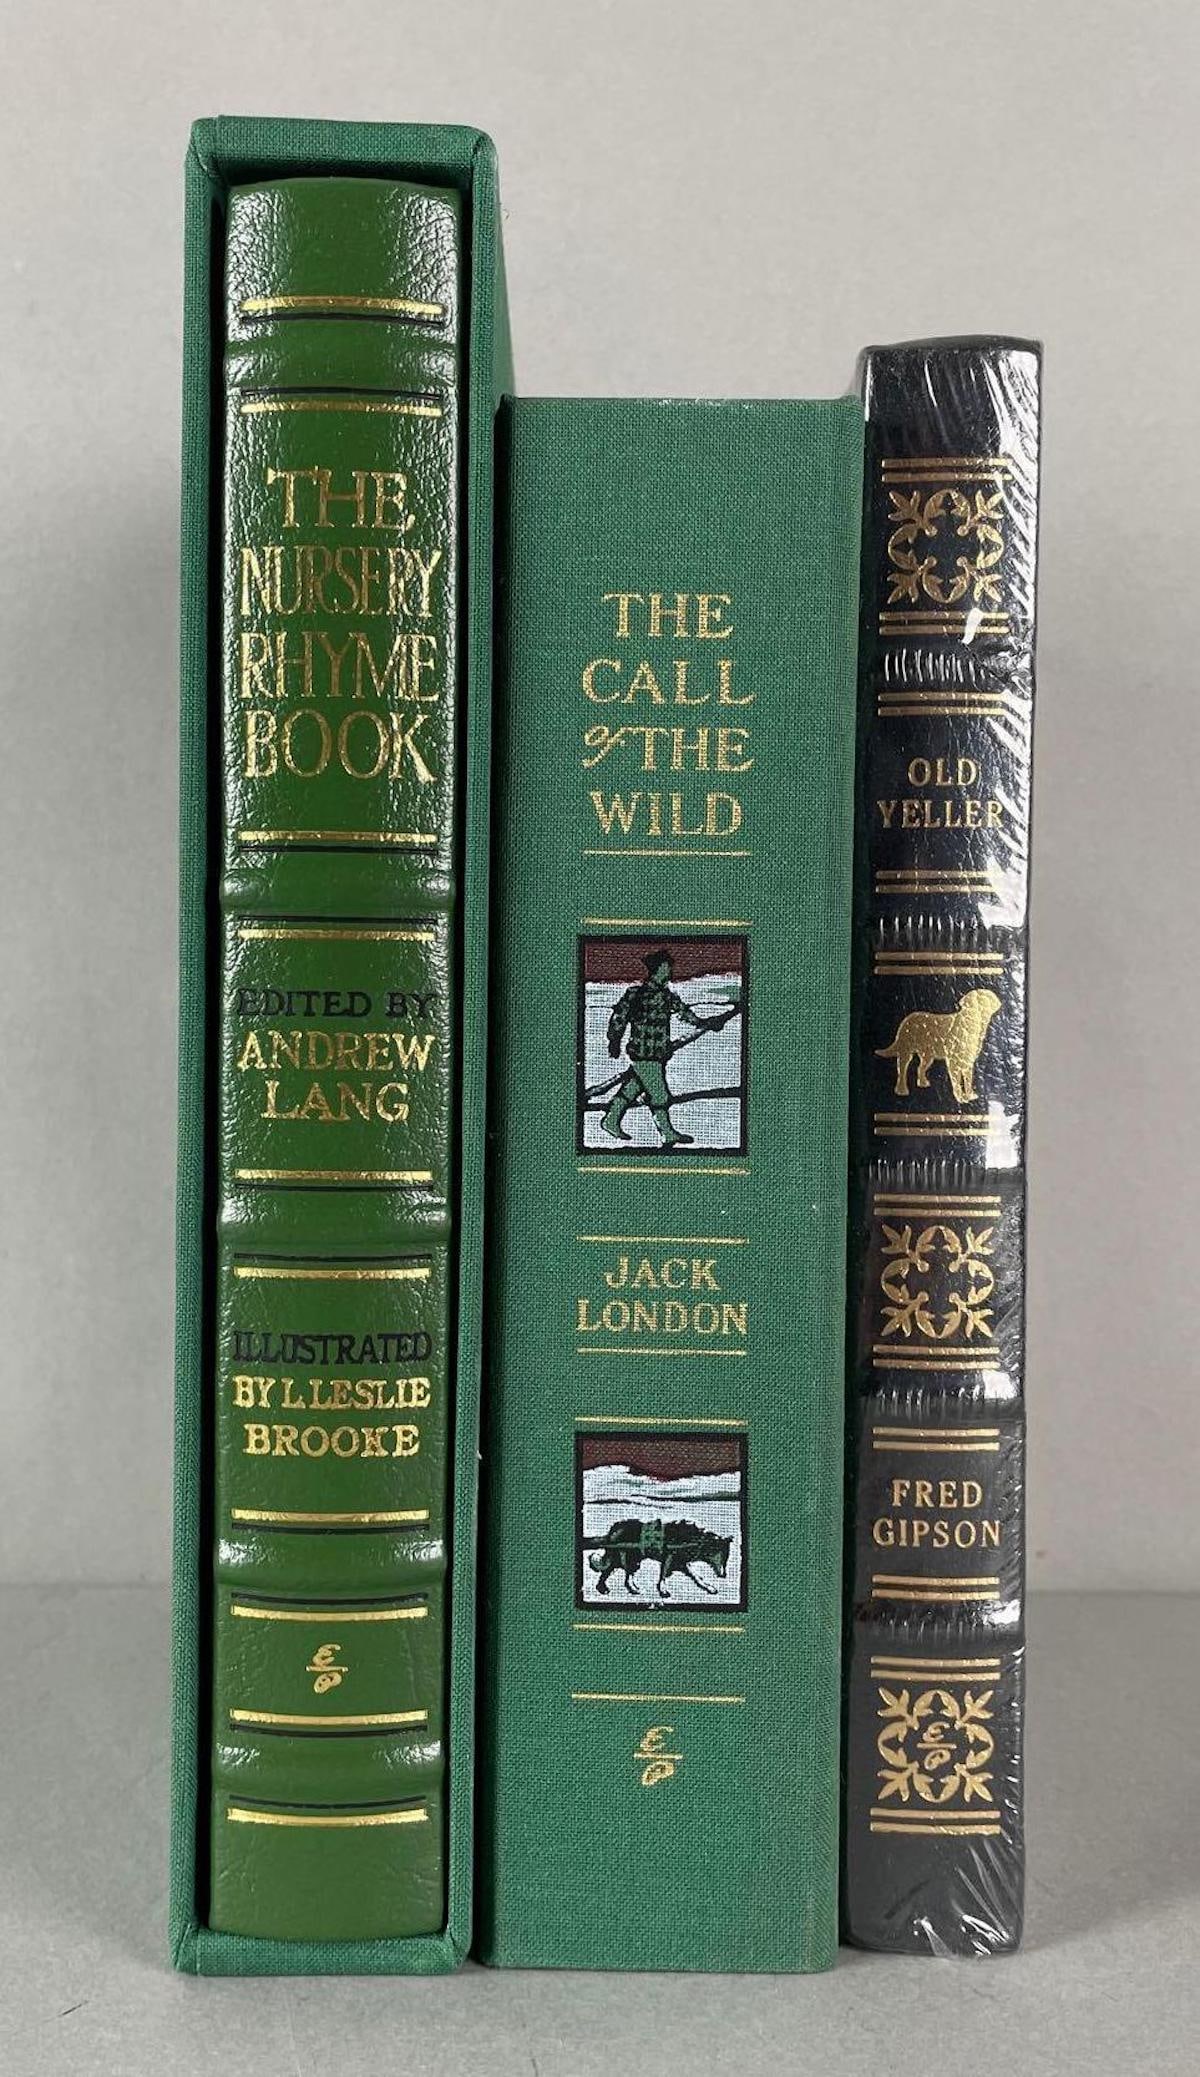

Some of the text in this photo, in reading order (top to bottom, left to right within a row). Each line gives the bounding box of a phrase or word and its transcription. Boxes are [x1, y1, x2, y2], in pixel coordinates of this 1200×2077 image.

[267, 467, 416, 529] THE
[240, 546, 441, 618] NURSERY
[603, 592, 733, 639] THE
[239, 631, 440, 701] RHYME
[582, 658, 756, 705] CALL
[244, 708, 438, 783] BOOK
[620, 726, 754, 772] THE
[908, 757, 977, 787] OLD
[589, 790, 742, 836] WILD
[876, 800, 1004, 829] YELLER
[237, 988, 436, 1018] EDITED BY
[237, 1030, 436, 1072] ANDREW
[260, 1080, 410, 1122] LANG
[603, 1255, 721, 1291] JACK
[576, 1297, 749, 1335] LONDON
[232, 1331, 433, 1366] ILLUSTRATED
[232, 1375, 276, 1408] BY
[308, 1376, 432, 1410] LESLIE
[242, 1423, 421, 1458] BROOKE
[891, 1479, 983, 1508] FRED
[872, 1517, 1001, 1548] GIPSON
